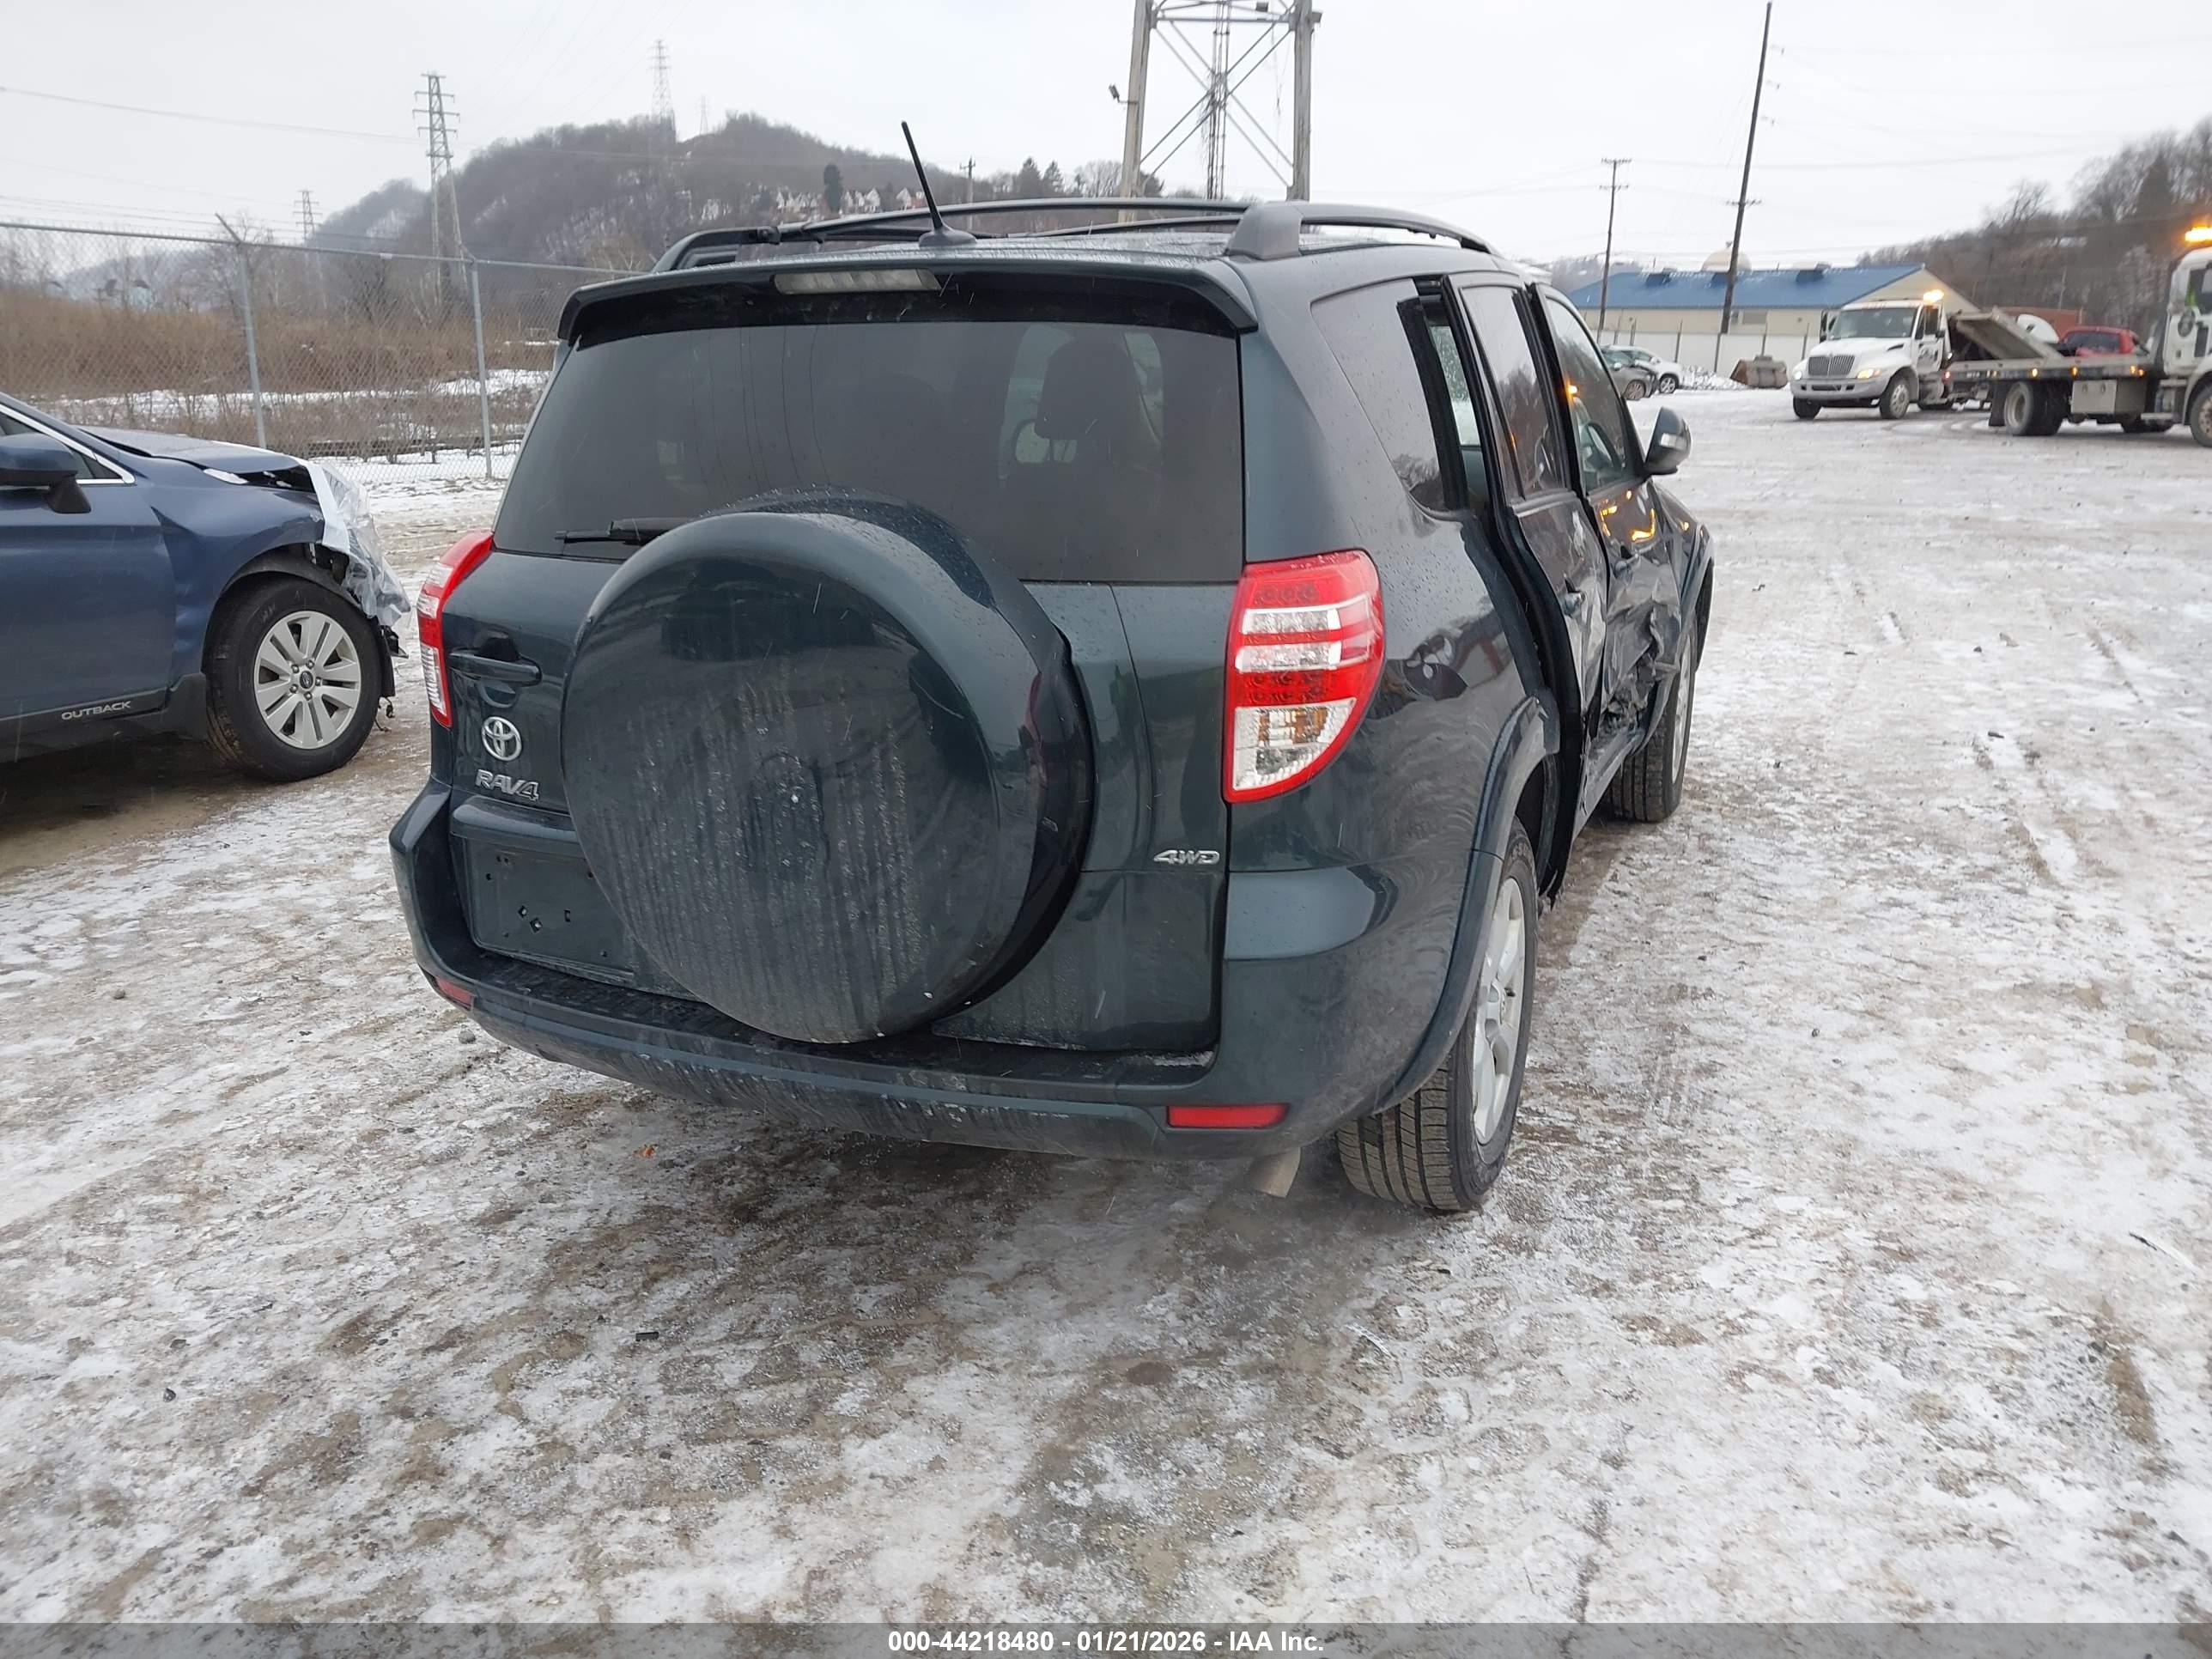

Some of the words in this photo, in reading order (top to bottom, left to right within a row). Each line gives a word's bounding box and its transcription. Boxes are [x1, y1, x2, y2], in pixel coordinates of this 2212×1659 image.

[61, 701, 131, 720] OUTBACK
[475, 769, 539, 801] RAV4
[1152, 849, 1220, 865] 4WD
